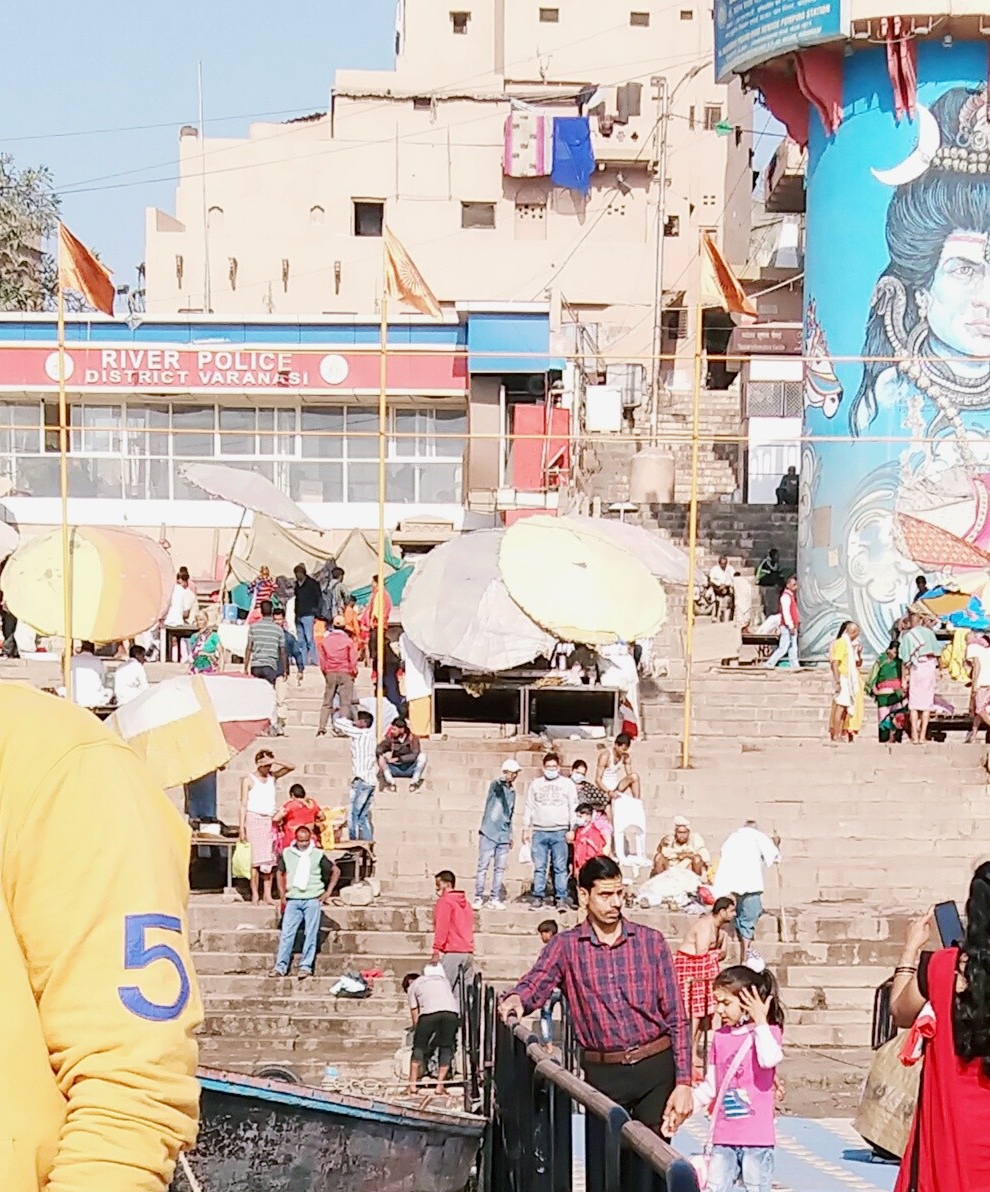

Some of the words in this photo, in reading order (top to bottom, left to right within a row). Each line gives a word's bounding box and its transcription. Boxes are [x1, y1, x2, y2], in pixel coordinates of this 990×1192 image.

[101, 350, 180, 370] RIVER
[197, 352, 292, 371] POLICE
[85, 370, 189, 384] DISTRICT
[198, 372, 309, 386] VARANASI
[118, 913, 190, 1021] 5
